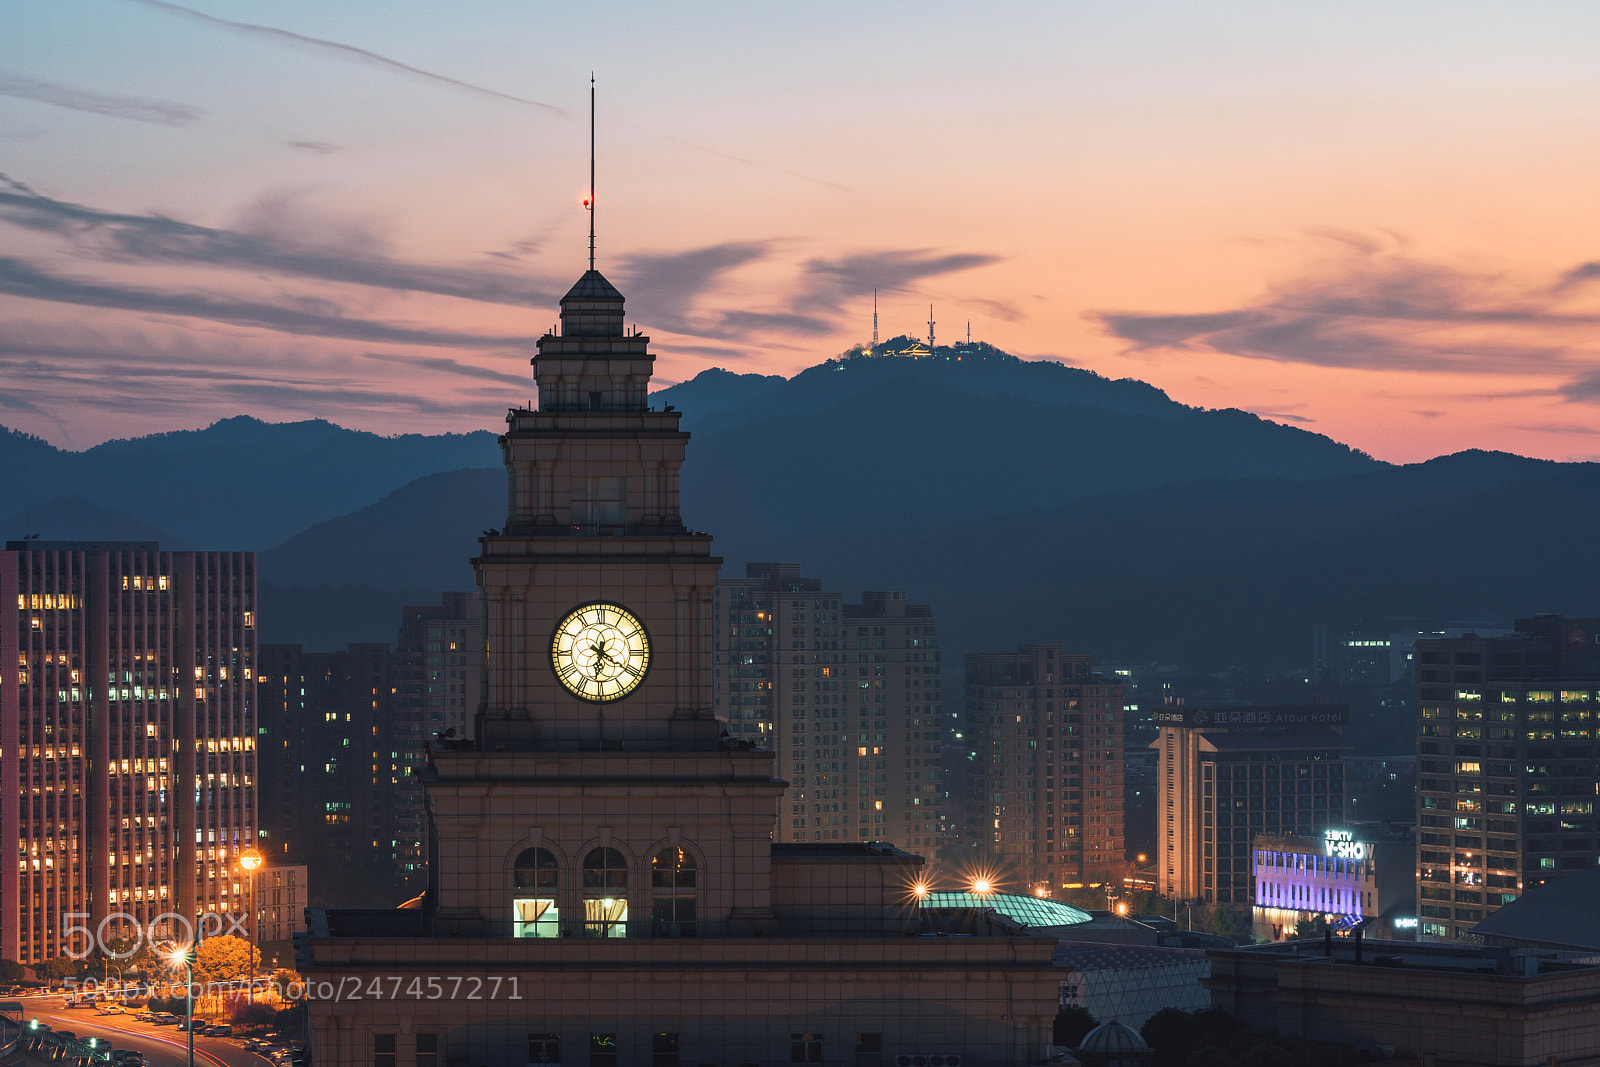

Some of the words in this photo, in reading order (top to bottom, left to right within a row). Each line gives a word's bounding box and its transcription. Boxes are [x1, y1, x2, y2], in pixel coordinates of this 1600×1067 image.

[1213, 711, 1271, 724] 亚朵酒店
[1276, 713, 1307, 723] Atour
[1311, 712, 1341, 722] Hotel
